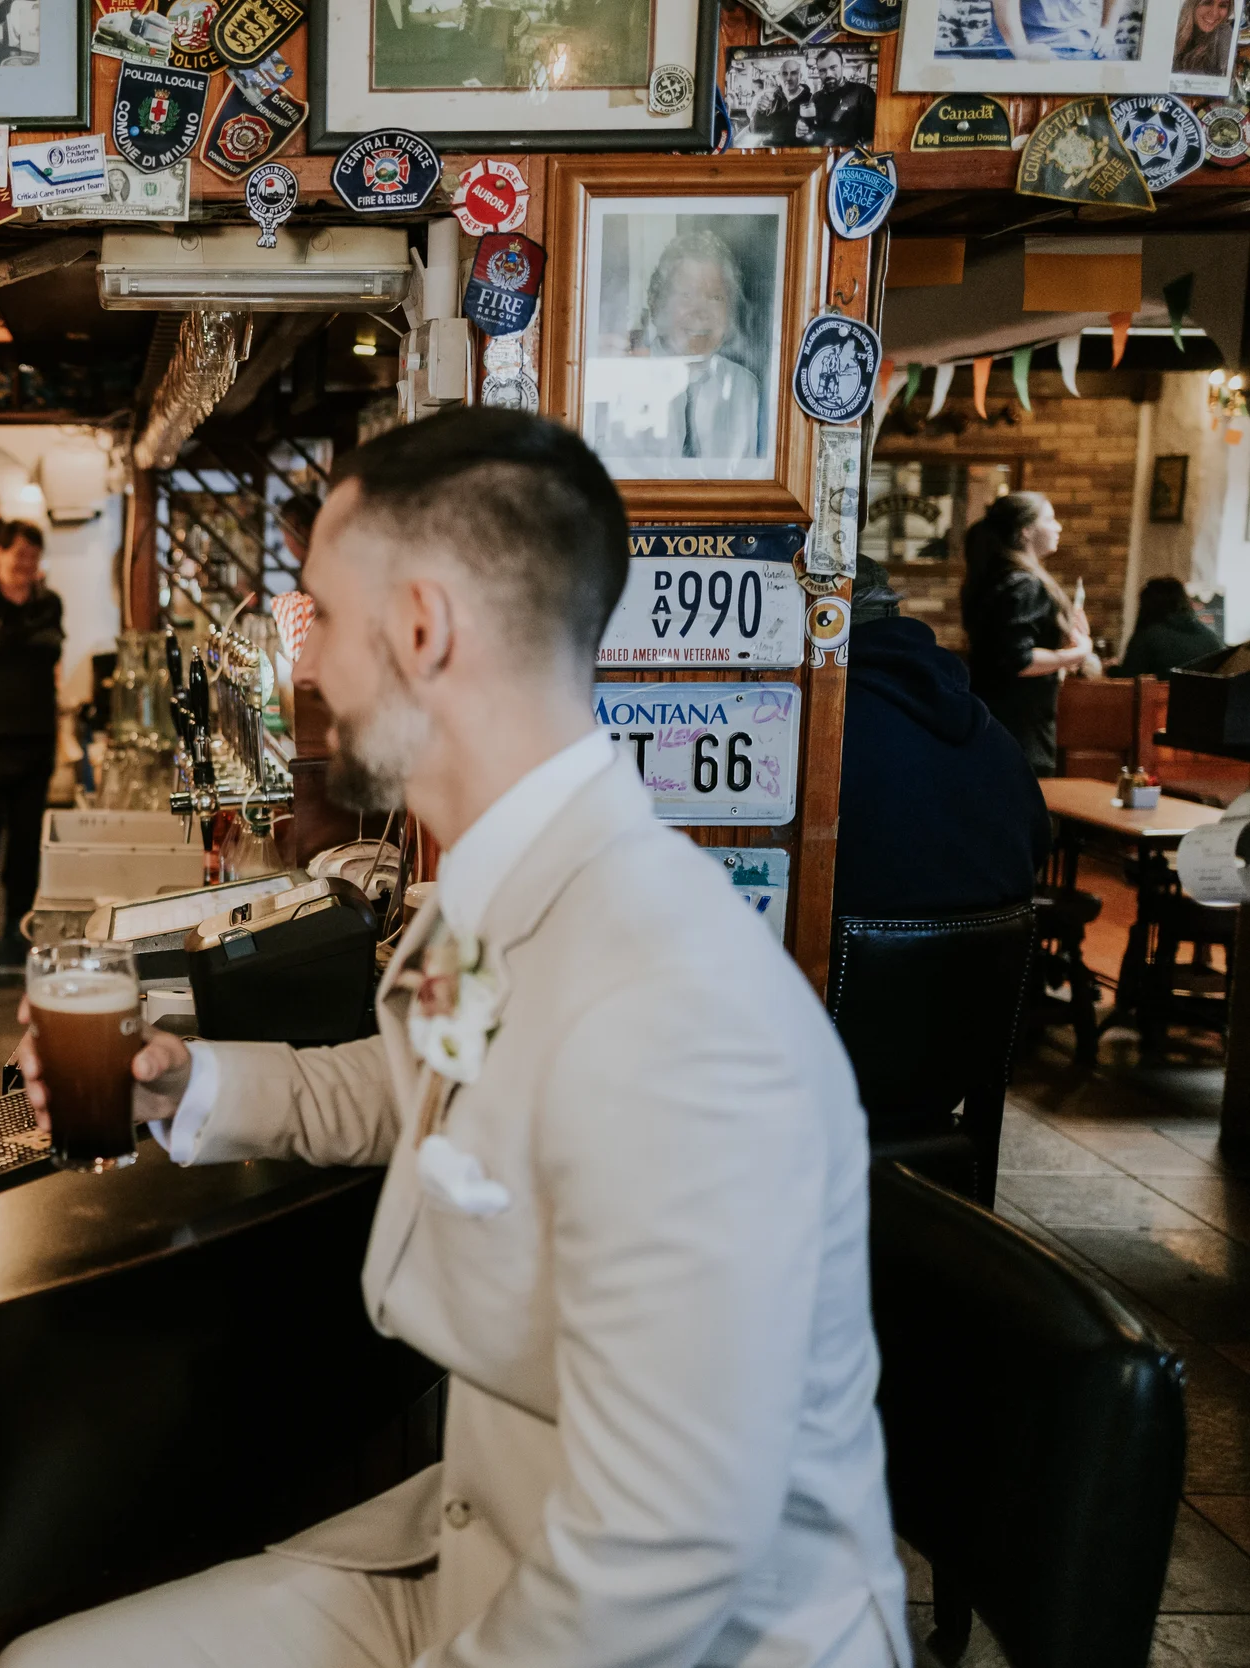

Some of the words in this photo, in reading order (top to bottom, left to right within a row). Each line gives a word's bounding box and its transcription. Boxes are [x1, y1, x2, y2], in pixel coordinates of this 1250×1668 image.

[806, 12, 827, 26] SINCE
[850, 15, 901, 30] VOLUNTEE
[124, 67, 163, 83] POLIZIA
[164, 76, 205, 91] LOCALE
[253, 72, 271, 90] 2017
[255, 103, 292, 128] DEPARTMENT
[659, 103, 686, 114] LOGAN
[117, 100, 139, 161] COMUNE
[141, 155, 156, 168] DI
[159, 112, 200, 166] MILANO
[942, 134, 975, 143] Customs
[976, 133, 1008, 143] Douanes
[1171, 106, 1200, 149] COUNTY
[65, 143, 91, 151] Boston
[65, 147, 100, 158] Children's
[1024, 103, 1095, 183] CONNECTICUT
[65, 154, 96, 166] Hospital
[207, 150, 242, 174] CONNECTICUT
[340, 135, 390, 175] CENTRAL
[395, 135, 434, 170] PIERCE
[175, 163, 184, 175] 2
[251, 166, 294, 186] WASHINGTON
[496, 164, 521, 186] FIRE
[1089, 157, 1123, 193] STATE
[1147, 171, 1178, 189] OFFICE
[16, 191, 37, 201] Critical
[38, 189, 55, 199] Care
[55, 184, 87, 196] Transport
[87, 181, 106, 190] Team
[837, 169, 892, 194] MASSACHUSETTS
[842, 181, 877, 199] STATE
[1099, 164, 1132, 200] POLICE
[250, 195, 267, 214] FIELD
[269, 196, 294, 215] OFFICE
[357, 195, 377, 206] FIRE
[377, 194, 385, 205] &
[385, 192, 418, 205] RESCUE
[470, 184, 510, 216] AURORA
[841, 191, 873, 209] POLICE
[460, 213, 489, 235] DEPT
[477, 288, 525, 316] FIRE
[477, 306, 518, 323] RESCUE
[803, 320, 852, 356] MASSACHUSETTS
[851, 325, 870, 348] TASK
[800, 368, 812, 398] URBAN
[806, 395, 832, 417] SEARCH
[830, 408, 846, 419] AND
[845, 385, 867, 415] RESCUE
[661, 534, 737, 558] YORK
[677, 570, 763, 639] 990
[632, 648, 680, 662] AMERICAN
[683, 647, 731, 662] VETERANS
[594, 696, 729, 726] MONTANA
[693, 731, 754, 793] 66
